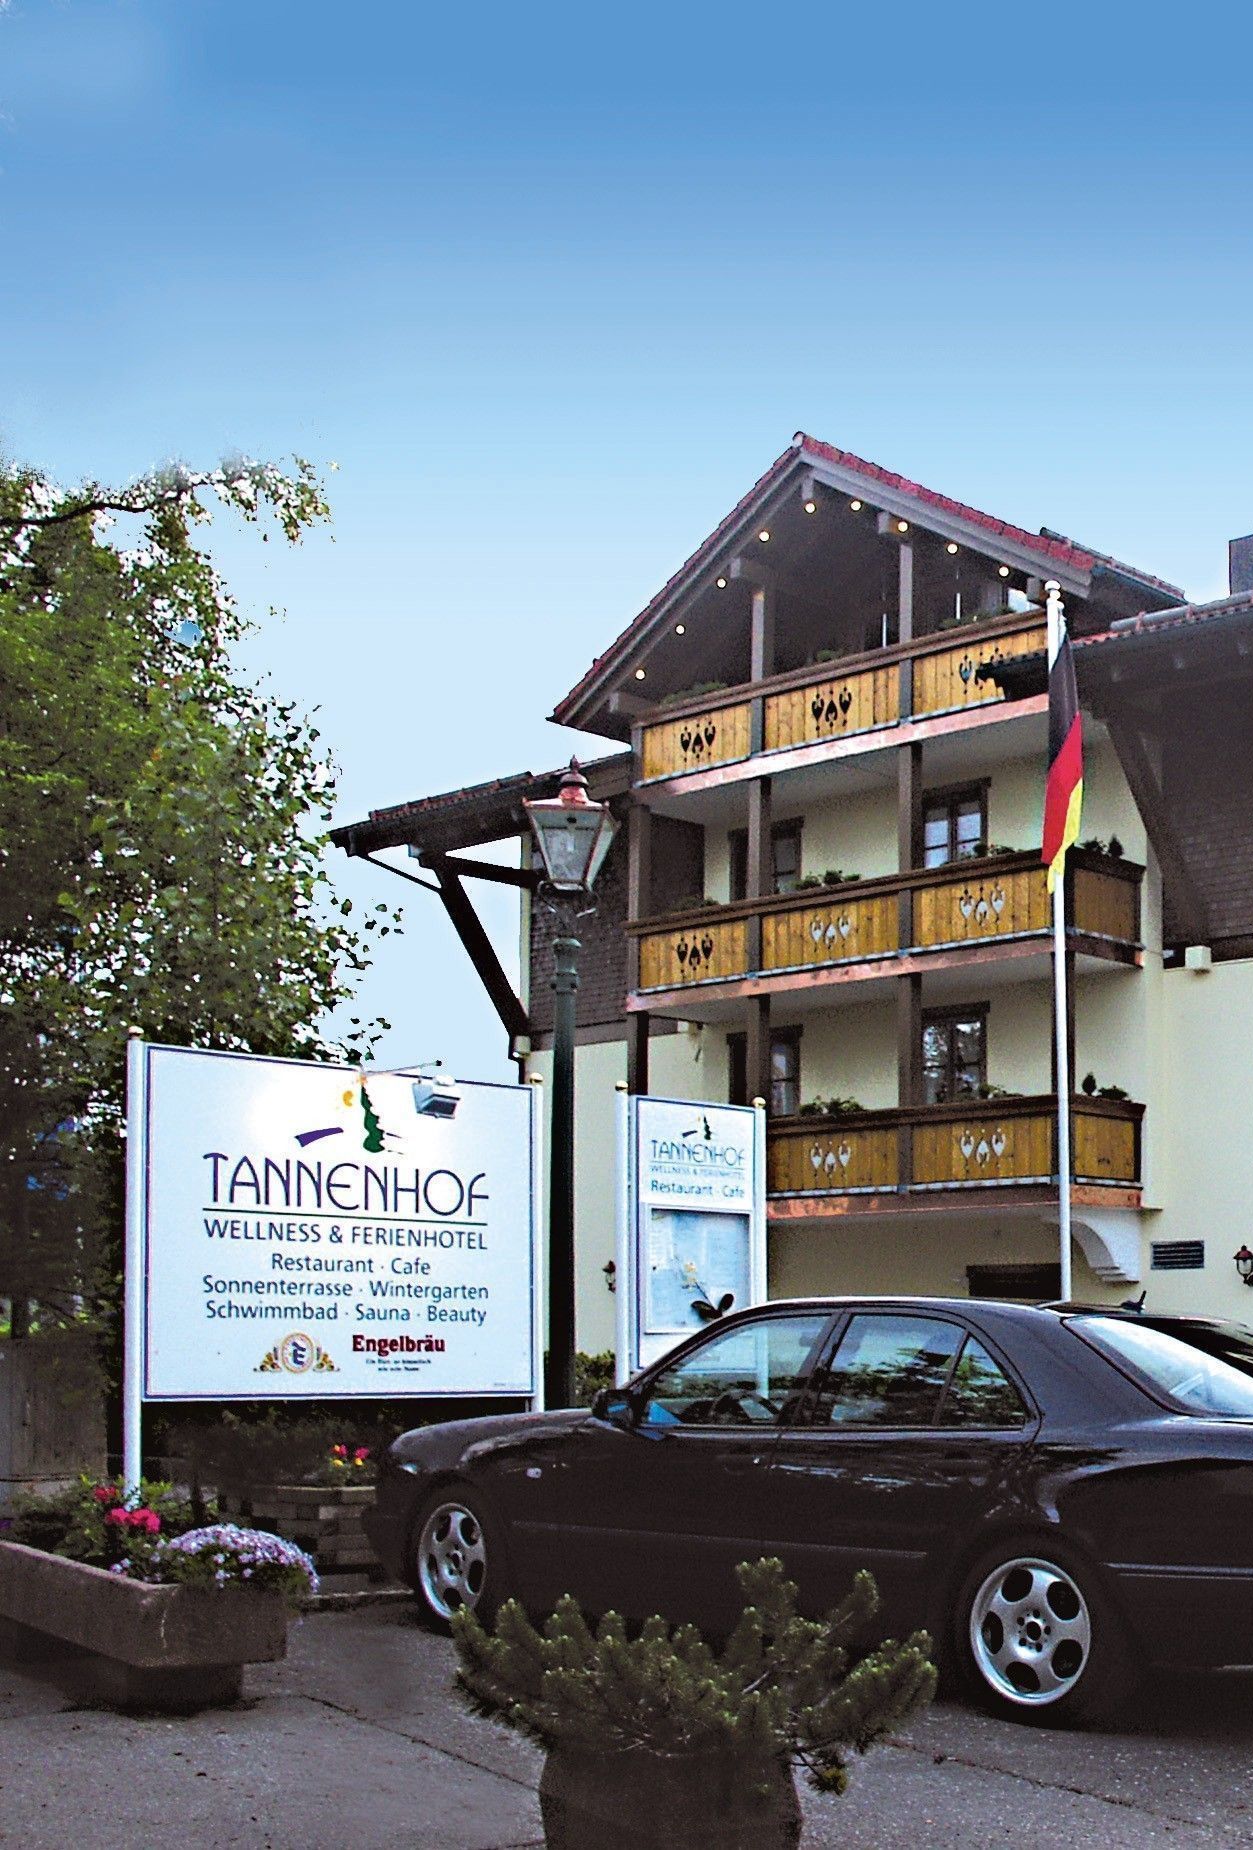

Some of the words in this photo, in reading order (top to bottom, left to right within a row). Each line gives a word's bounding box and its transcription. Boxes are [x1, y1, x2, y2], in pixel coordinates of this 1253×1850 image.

[651, 1139, 745, 1166] TANNENHOF
[202, 1152, 490, 1217] TANNENHOF
[651, 1180, 713, 1196] Restaurant
[203, 1218, 322, 1243] WELLNESS
[329, 1224, 343, 1244] &
[351, 1226, 488, 1250] FERIENHOTEL
[271, 1252, 374, 1274] Restaurant
[391, 1257, 431, 1275] Cafe
[202, 1274, 353, 1297] Sonnenterrasse
[369, 1280, 489, 1303] Wintergarten
[206, 1299, 338, 1320] Schwimmbad
[355, 1303, 411, 1321] Sauna
[427, 1304, 487, 1327] Beauty
[352, 1334, 446, 1357] Engelbräu
